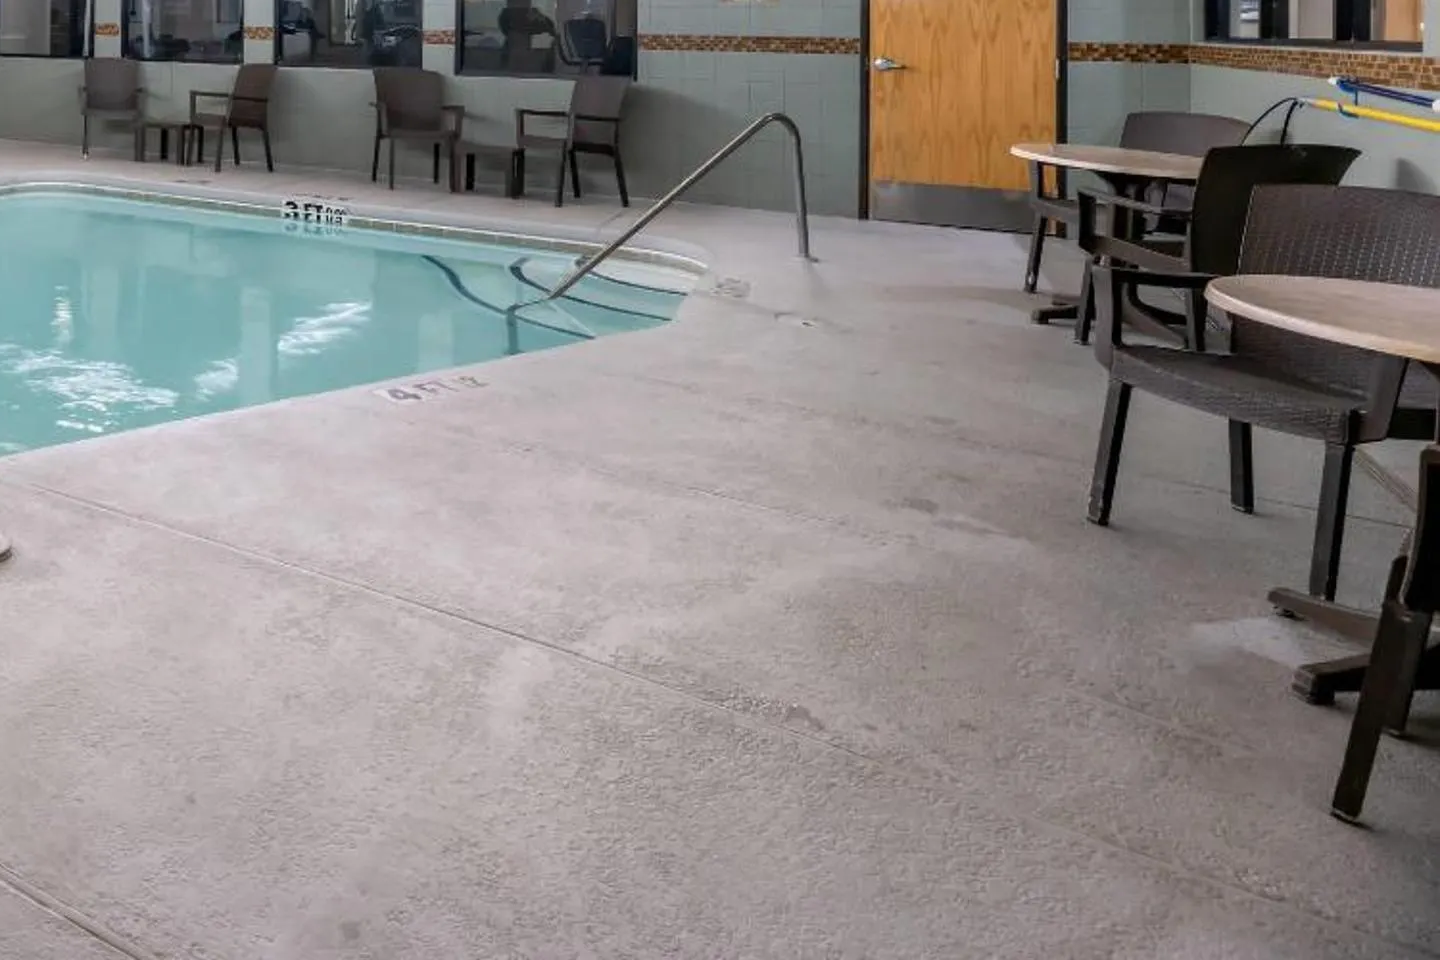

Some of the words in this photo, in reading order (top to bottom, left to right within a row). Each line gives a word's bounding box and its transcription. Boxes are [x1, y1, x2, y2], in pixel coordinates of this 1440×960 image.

[285, 201, 298, 221] 3
[303, 203, 323, 224] FT
[387, 389, 423, 401] 4
